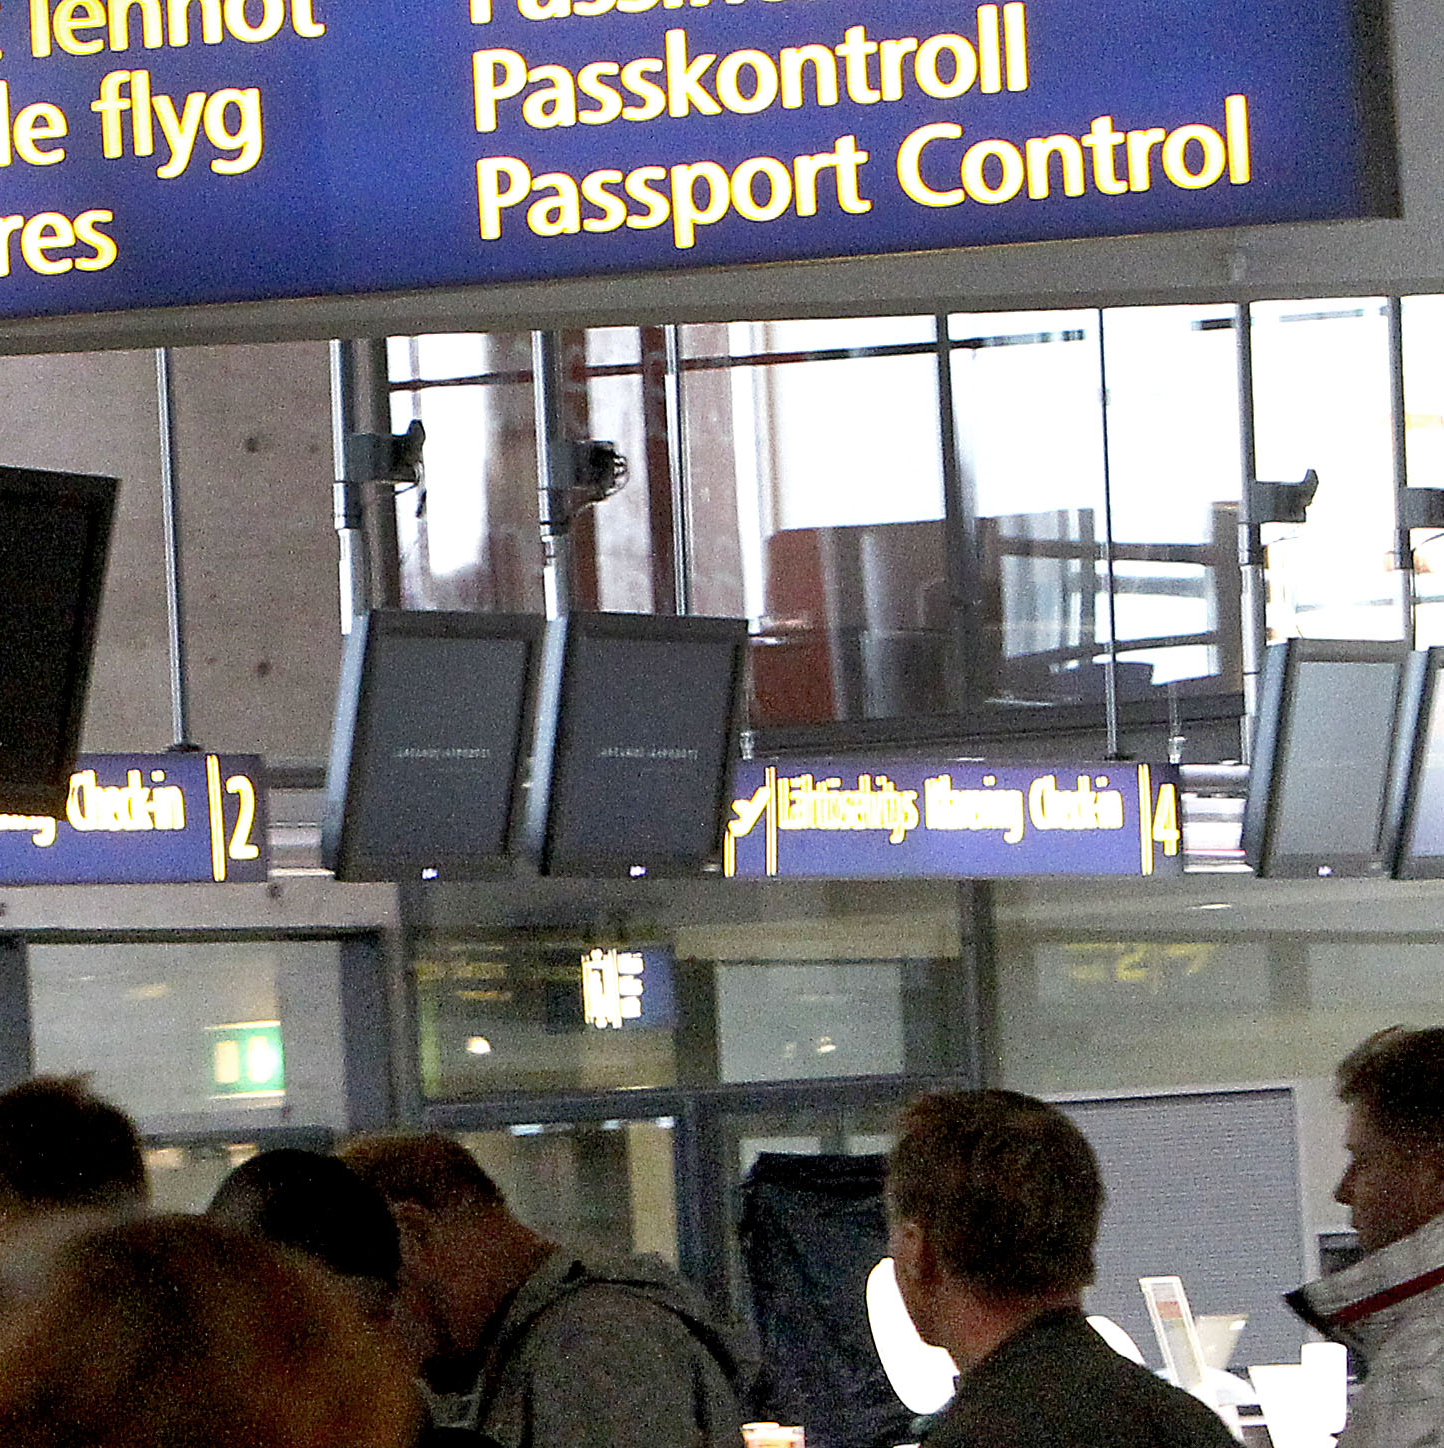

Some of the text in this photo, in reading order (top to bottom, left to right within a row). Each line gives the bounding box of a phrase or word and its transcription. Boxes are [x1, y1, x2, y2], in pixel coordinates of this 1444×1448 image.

[472, 2, 1028, 133] Passkontroll
[90, 69, 263, 179] flyg
[476, 93, 1250, 249] Passport Control
[225, 775, 260, 859] 2
[1150, 783, 1181, 857] 4
